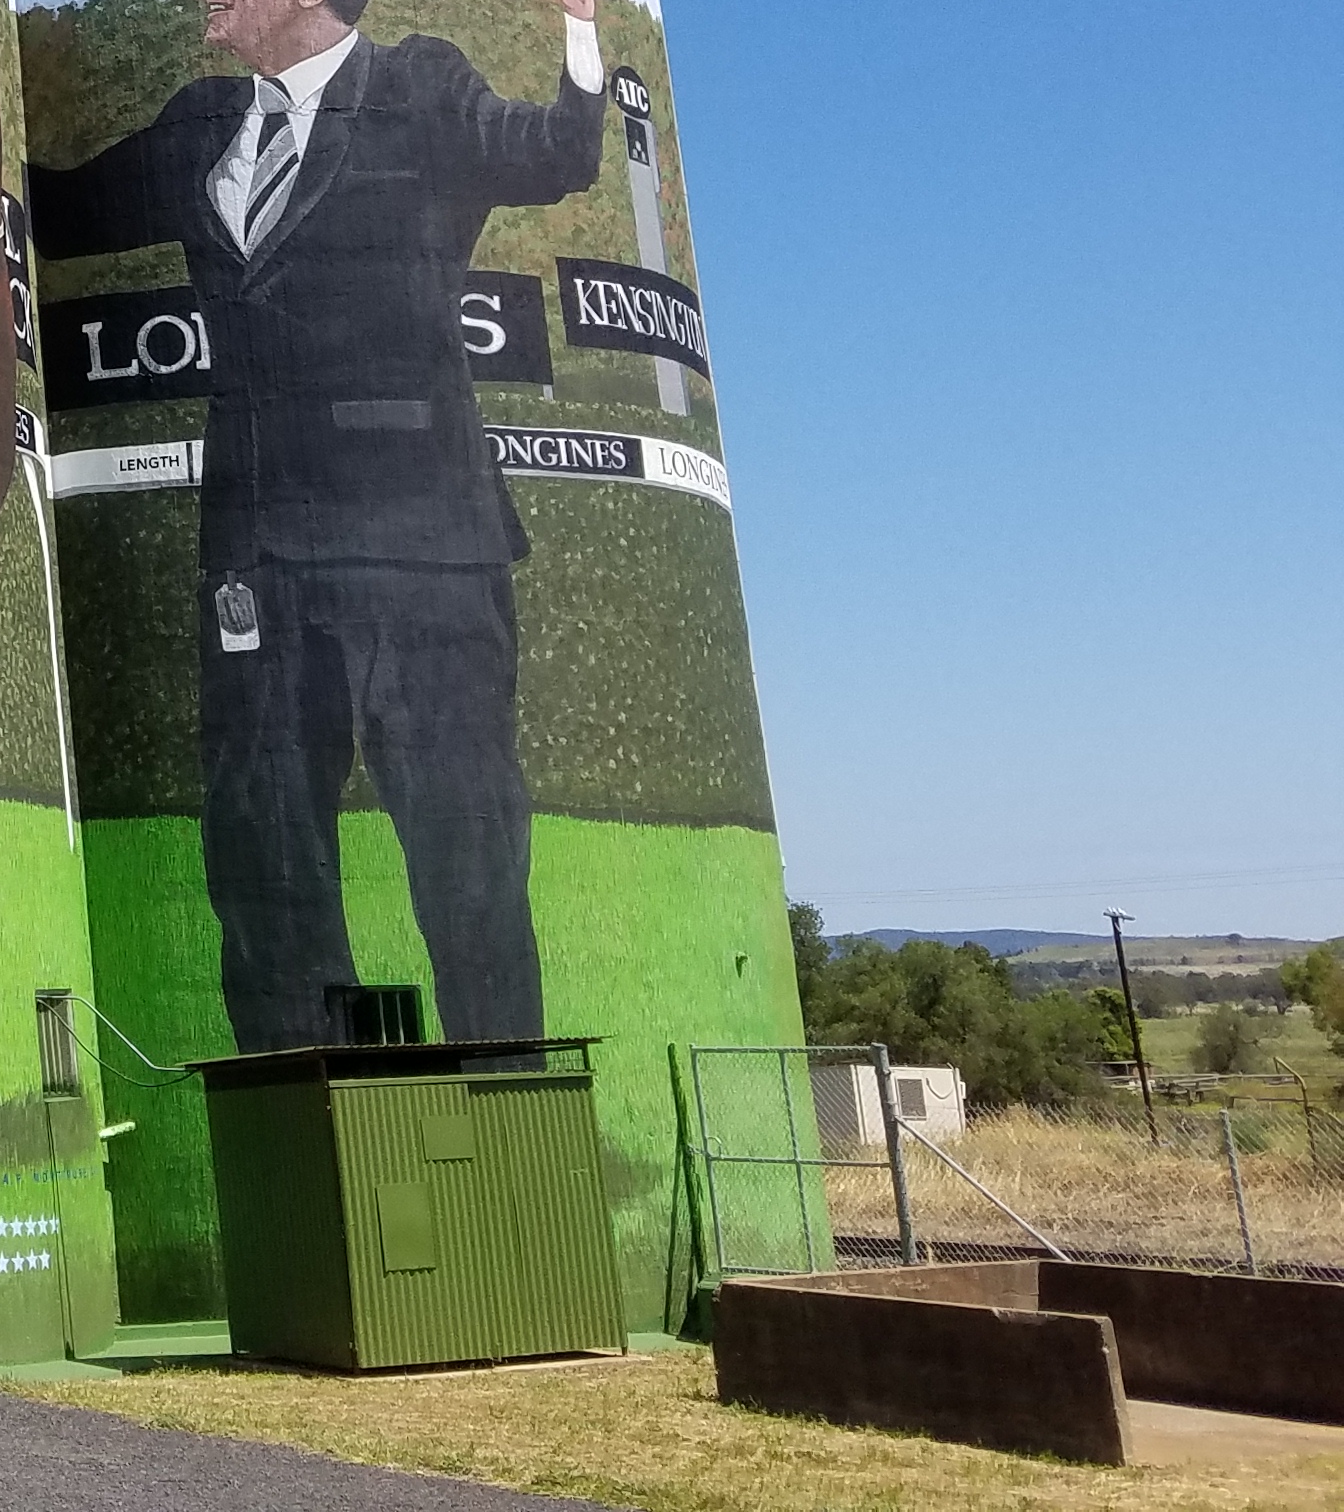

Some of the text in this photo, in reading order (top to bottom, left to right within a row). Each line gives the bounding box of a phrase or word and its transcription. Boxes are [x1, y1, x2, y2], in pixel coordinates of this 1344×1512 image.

[616, 77, 649, 112] ATC
[574, 278, 707, 362] KENSINGTON
[119, 455, 180, 472] LENGTH
